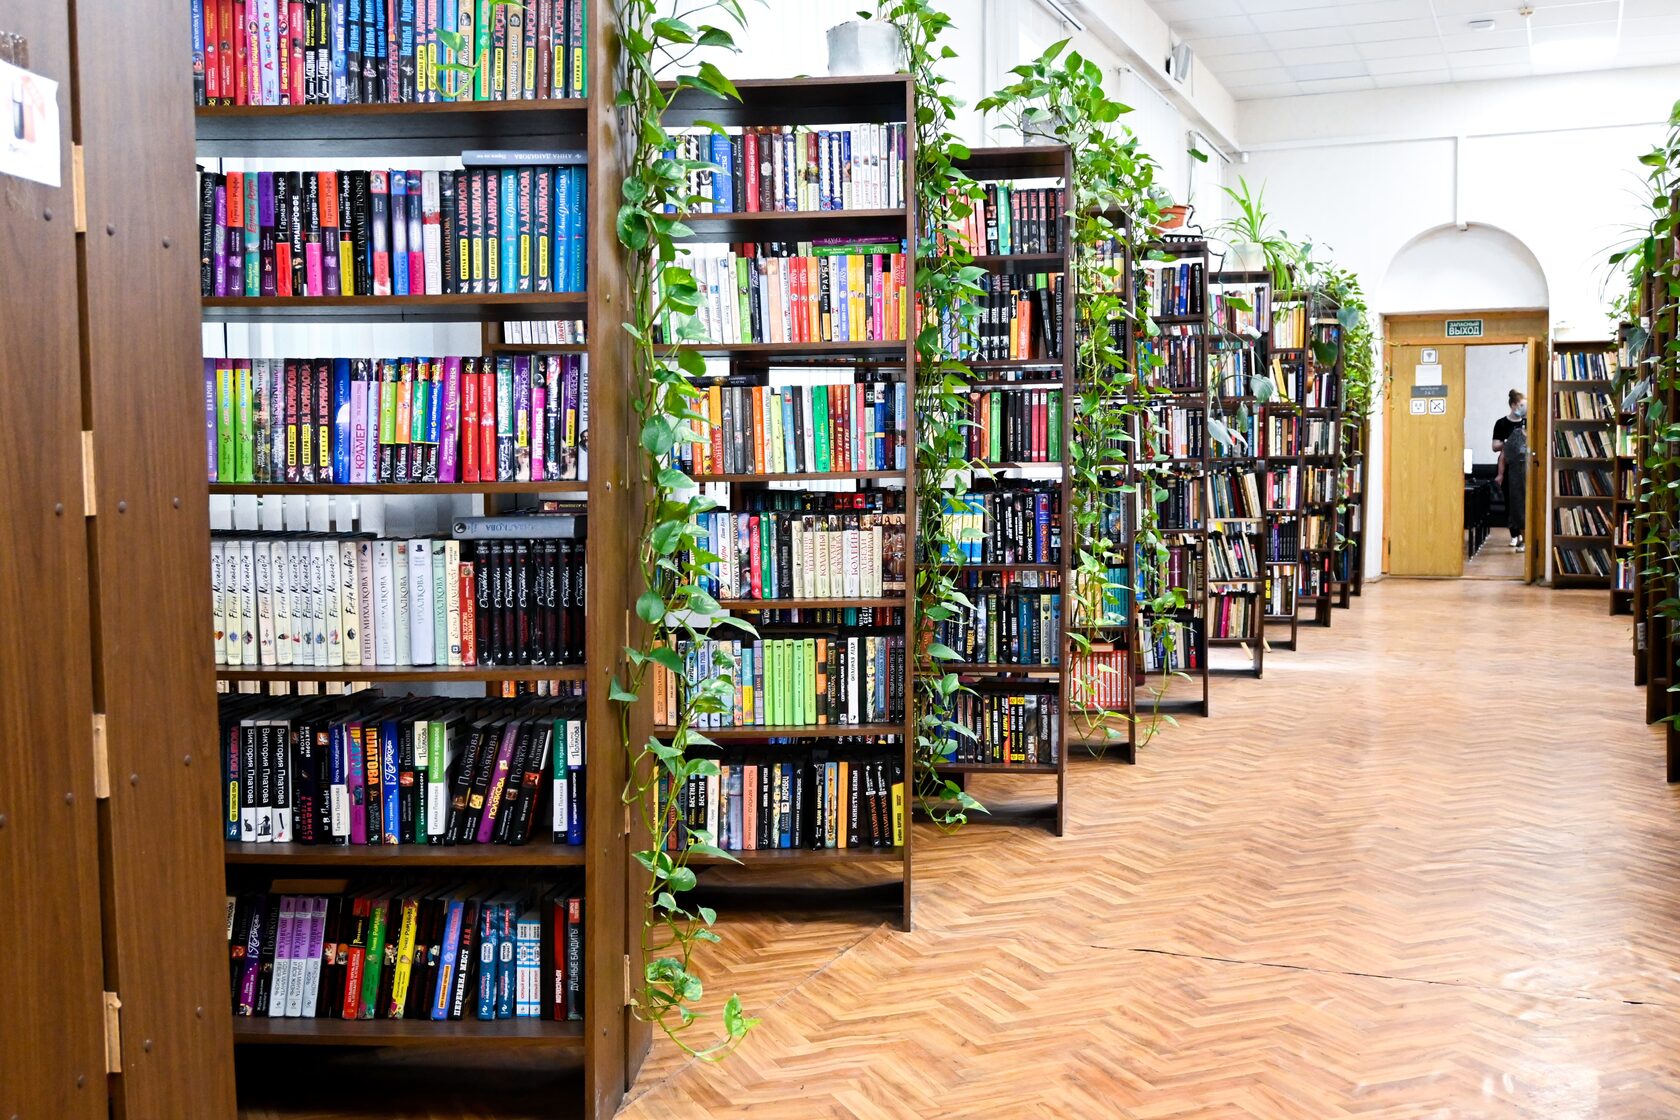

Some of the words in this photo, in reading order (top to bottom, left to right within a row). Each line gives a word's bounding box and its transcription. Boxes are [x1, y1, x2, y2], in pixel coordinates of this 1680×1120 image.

[348, 25, 359, 52] Наталья
[363, 28, 375, 57] Наталья
[377, 31, 386, 58] Наталья
[401, 26, 412, 56] Наталья
[526, 39, 535, 47] Е.
[574, 39, 582, 47] Е.
[279, 177, 287, 230] Гармаш-Роффе
[309, 176, 319, 229] Гармаш-Роффе
[342, 175, 352, 228] Гармаш-Роффе
[458, 175, 468, 227] ДАНИЛОВА
[472, 175, 481, 227] ДАНИЛОВА
[488, 175, 497, 226] ДАНИЛОВА
[520, 171, 529, 223] ДАНИЛОВА
[539, 172, 548, 224] ДАНИЛОВА
[444, 217, 452, 258] ДАНИЛОВА
[459, 228, 468, 237] А.
[472, 227, 481, 237] А.
[488, 227, 497, 236] А.
[520, 224, 529, 233] А.
[539, 226, 548, 235] А.
[820, 266, 831, 296] ТРАУБ
[1449, 326, 1479, 335] ВЫХОД
[287, 365, 297, 414] КОРНИЛОВА
[302, 364, 311, 414] КОРНИЛОВА
[319, 366, 329, 416] КОРНИЛОВА
[446, 367, 457, 411] Куликова
[288, 415, 297, 424] Н.
[302, 414, 311, 423] Н.
[319, 416, 329, 425] Н.
[535, 408, 544, 460] ЛИТВИНОВЫ
[288, 441, 296, 465] ПАНТЕРА
[356, 423, 366, 470] КРАМЕР
[819, 534, 827, 577] КОЛДУНЬЯ
[361, 576, 371, 630] МИХАЛКОВА
[363, 633, 371, 660] ЕЛЕНА
[247, 728, 256, 768] Виктория
[262, 728, 271, 767] Виктория
[277, 728, 287, 768] Виктория
[366, 730, 379, 785] ПЛАТОВА
[385, 740, 397, 781] Полякова
[403, 729, 412, 766] Полякова
[418, 727, 428, 759] Полякова
[458, 733, 479, 786] Полякова
[510, 734, 530, 783] Полякова
[532, 731, 546, 767] Полякова
[571, 726, 581, 759] Полякова
[476, 735, 498, 787] Полякова
[247, 769, 255, 804] Платова
[262, 768, 271, 803] Платова
[277, 769, 286, 805] Платова
[488, 777, 506, 819] ПОЛЯКОВА
[688, 782, 696, 808] БЕСТИЯ
[781, 776, 789, 801] ЖЕРЕБЕЦ
[247, 914, 260, 956] Полякова
[404, 907, 413, 937] РОМАНОВА
[459, 949, 469, 971] МЕСТ
[570, 928, 579, 961] БАНДИТЫ
[453, 973, 466, 1017] ПЕРЕМЕНА
